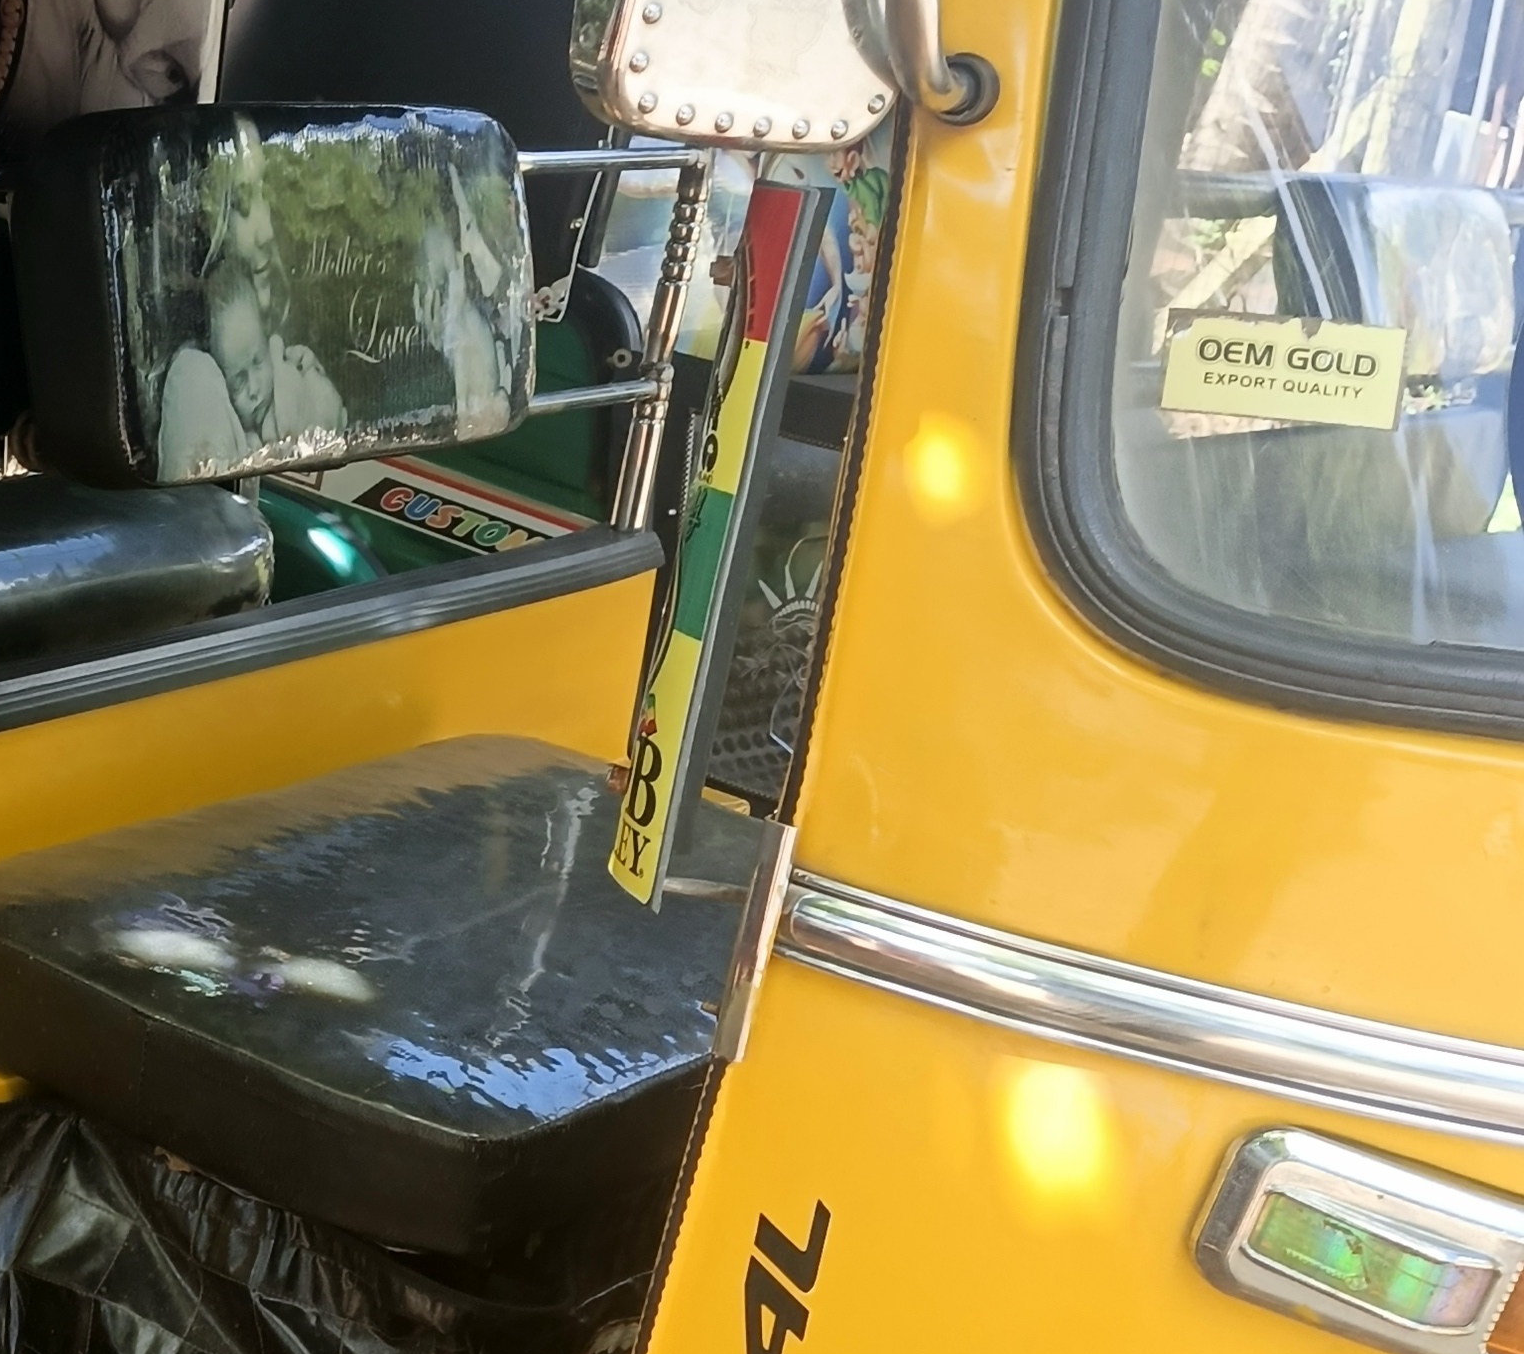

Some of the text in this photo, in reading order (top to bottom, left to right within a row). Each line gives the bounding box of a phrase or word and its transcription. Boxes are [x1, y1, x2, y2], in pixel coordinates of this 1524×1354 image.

[1198, 338, 1377, 377] OEM GOLD
[1203, 371, 1363, 399] EXPORT QUALITY
